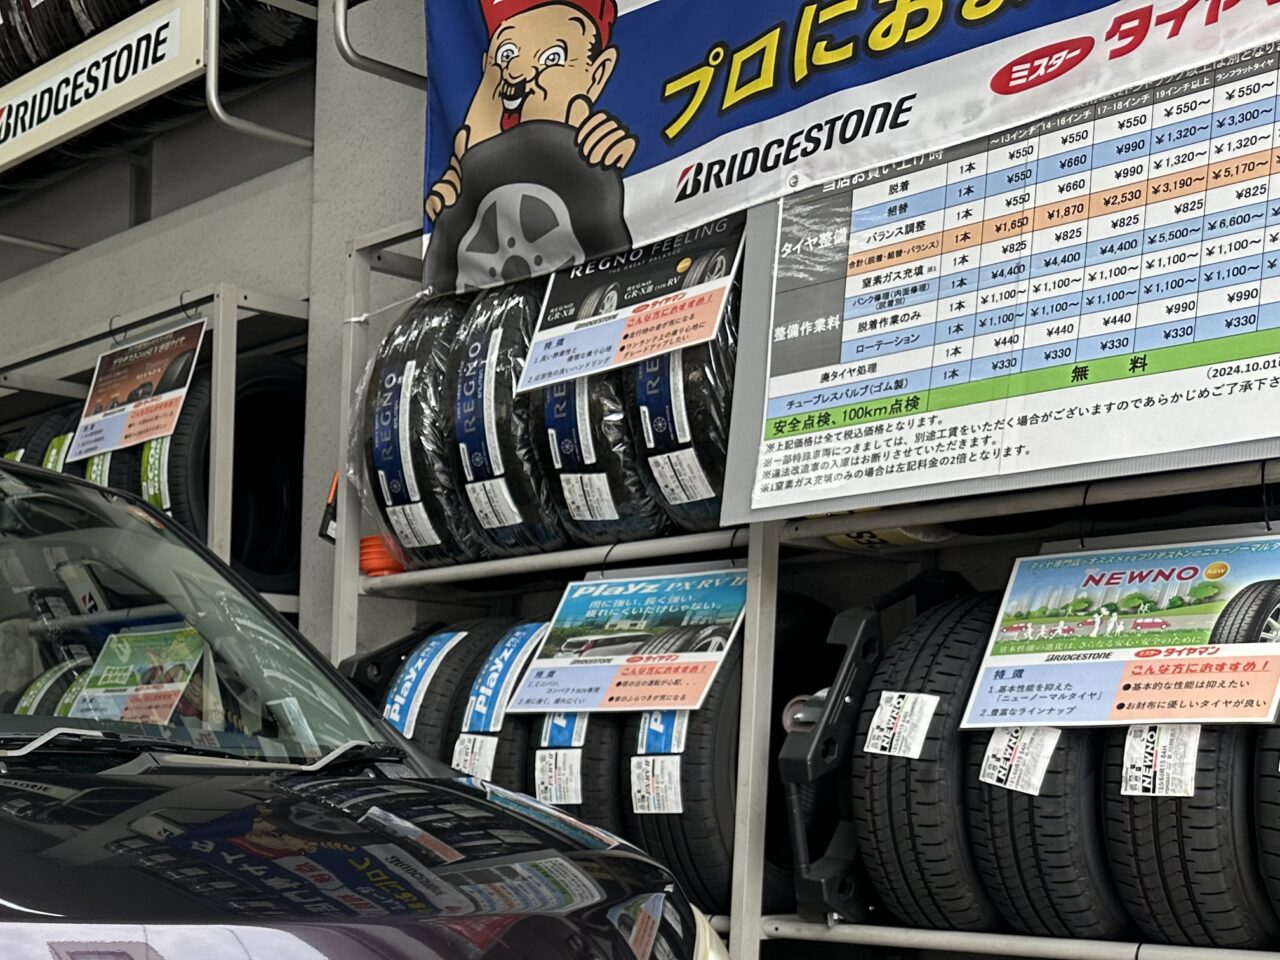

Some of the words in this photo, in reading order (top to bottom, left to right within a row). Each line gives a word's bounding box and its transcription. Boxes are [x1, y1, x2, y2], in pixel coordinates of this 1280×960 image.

[1009, 47, 1082, 88] ミスター
[1155, 77, 1211, 99] 19インチ以上
[1215, 58, 1275, 82] ランフラットタイヤ
[674, 93, 917, 203] BRIDGESTONE
[888, 180, 910, 196] 脱着
[1008, 145, 1034, 160] ¥550
[1061, 130, 1088, 145] ¥550
[1118, 114, 1147, 130] ¥550
[887, 203, 909, 217] 組替
[1007, 169, 1032, 184] ¥550
[1060, 154, 1087, 170] ¥660
[1116, 140, 1145, 155] ¥990
[867, 220, 926, 243] バランス調整
[1005, 193, 1030, 208] ¥550
[1058, 180, 1085, 194] ¥660
[1114, 165, 1144, 180] ¥990
[995, 217, 1029, 234] ¥1,650
[1047, 204, 1084, 220] ¥1,870
[1103, 190, 1142, 207] ¥2,530
[1002, 240, 1027, 255] ¥825
[1054, 228, 1082, 242] ¥825
[1111, 214, 1140, 229] ¥825
[1174, 199, 1204, 215] ¥825
[1236, 184, 1267, 200] ¥825
[570, 248, 643, 279] REGNO
[651, 218, 728, 254] FEELING
[991, 264, 1025, 281] ¥4,400
[1044, 252, 1081, 267] ¥4,400
[1100, 239, 1138, 255] ¥4,400
[773, 314, 840, 343] 整備作業料
[820, 363, 877, 384] 廃タイヤ処理
[994, 334, 1019, 348] ¥440
[1047, 324, 1074, 337] ¥440
[1103, 313, 1131, 327] ¥440
[1166, 301, 1196, 315] ¥990
[1227, 289, 1259, 303] ¥990
[857, 310, 922, 333] 脱着作業のみ
[992, 357, 1017, 371] ¥330
[1044, 348, 1071, 361] ¥330
[1100, 338, 1129, 351] ¥330
[1164, 326, 1193, 340] ¥330
[1225, 314, 1256, 329] ¥330
[856, 334, 920, 354] ローテーション
[463, 341, 481, 433] REGNO
[1071, 366, 1089, 382] 無
[1129, 354, 1148, 373] 料
[1207, 357, 1280, 379] (2024.10.01
[380, 372, 397, 461] REGNO
[1082, 565, 1200, 588] NEWNO
[1045, 652, 1113, 662] BRIDGESTONE
[1162, 646, 1220, 657] タイヤマン
[1125, 698, 1267, 710] お財布に優しいタイヤが良い
[1131, 680, 1250, 691] 基本的な性能は抑えたい
[998, 728, 1021, 781] NEWNO
[1142, 731, 1157, 788] NEWNO
